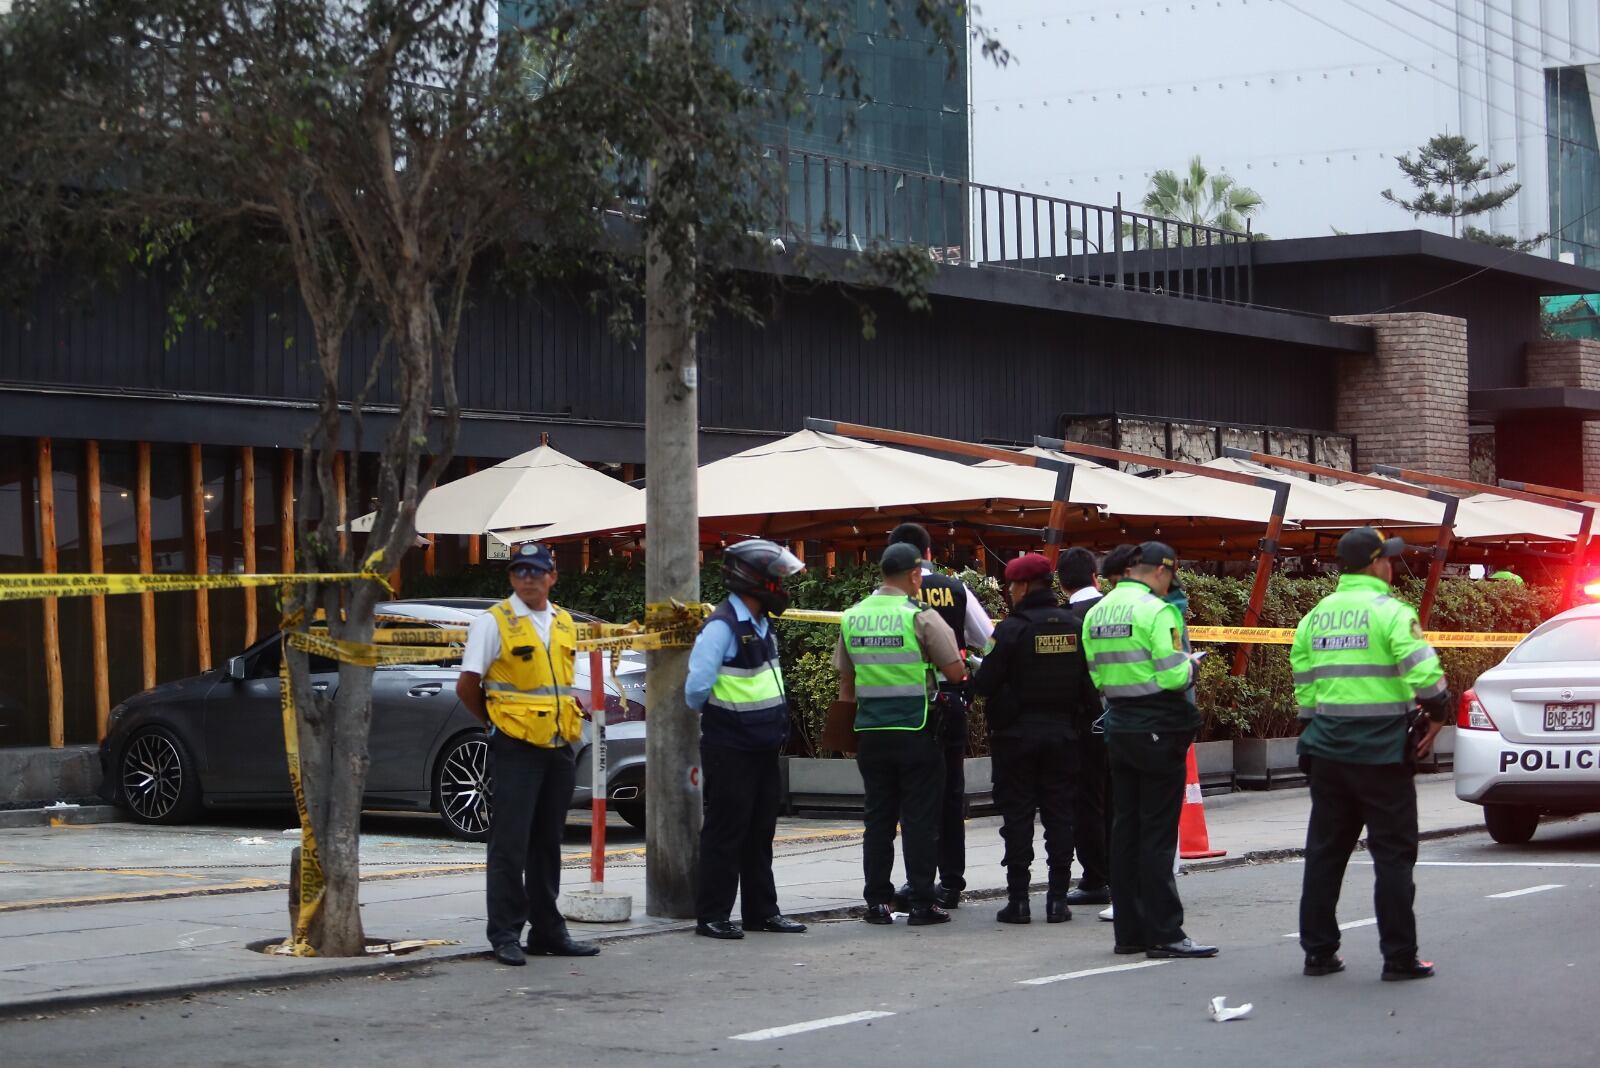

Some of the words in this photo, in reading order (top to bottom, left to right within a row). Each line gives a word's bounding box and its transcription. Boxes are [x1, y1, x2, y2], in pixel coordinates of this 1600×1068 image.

[848, 613, 904, 632] POLICIA
[1311, 609, 1370, 632] POLICIA
[1039, 636, 1069, 647] POLICIA
[1547, 711, 1591, 727] BNB-519
